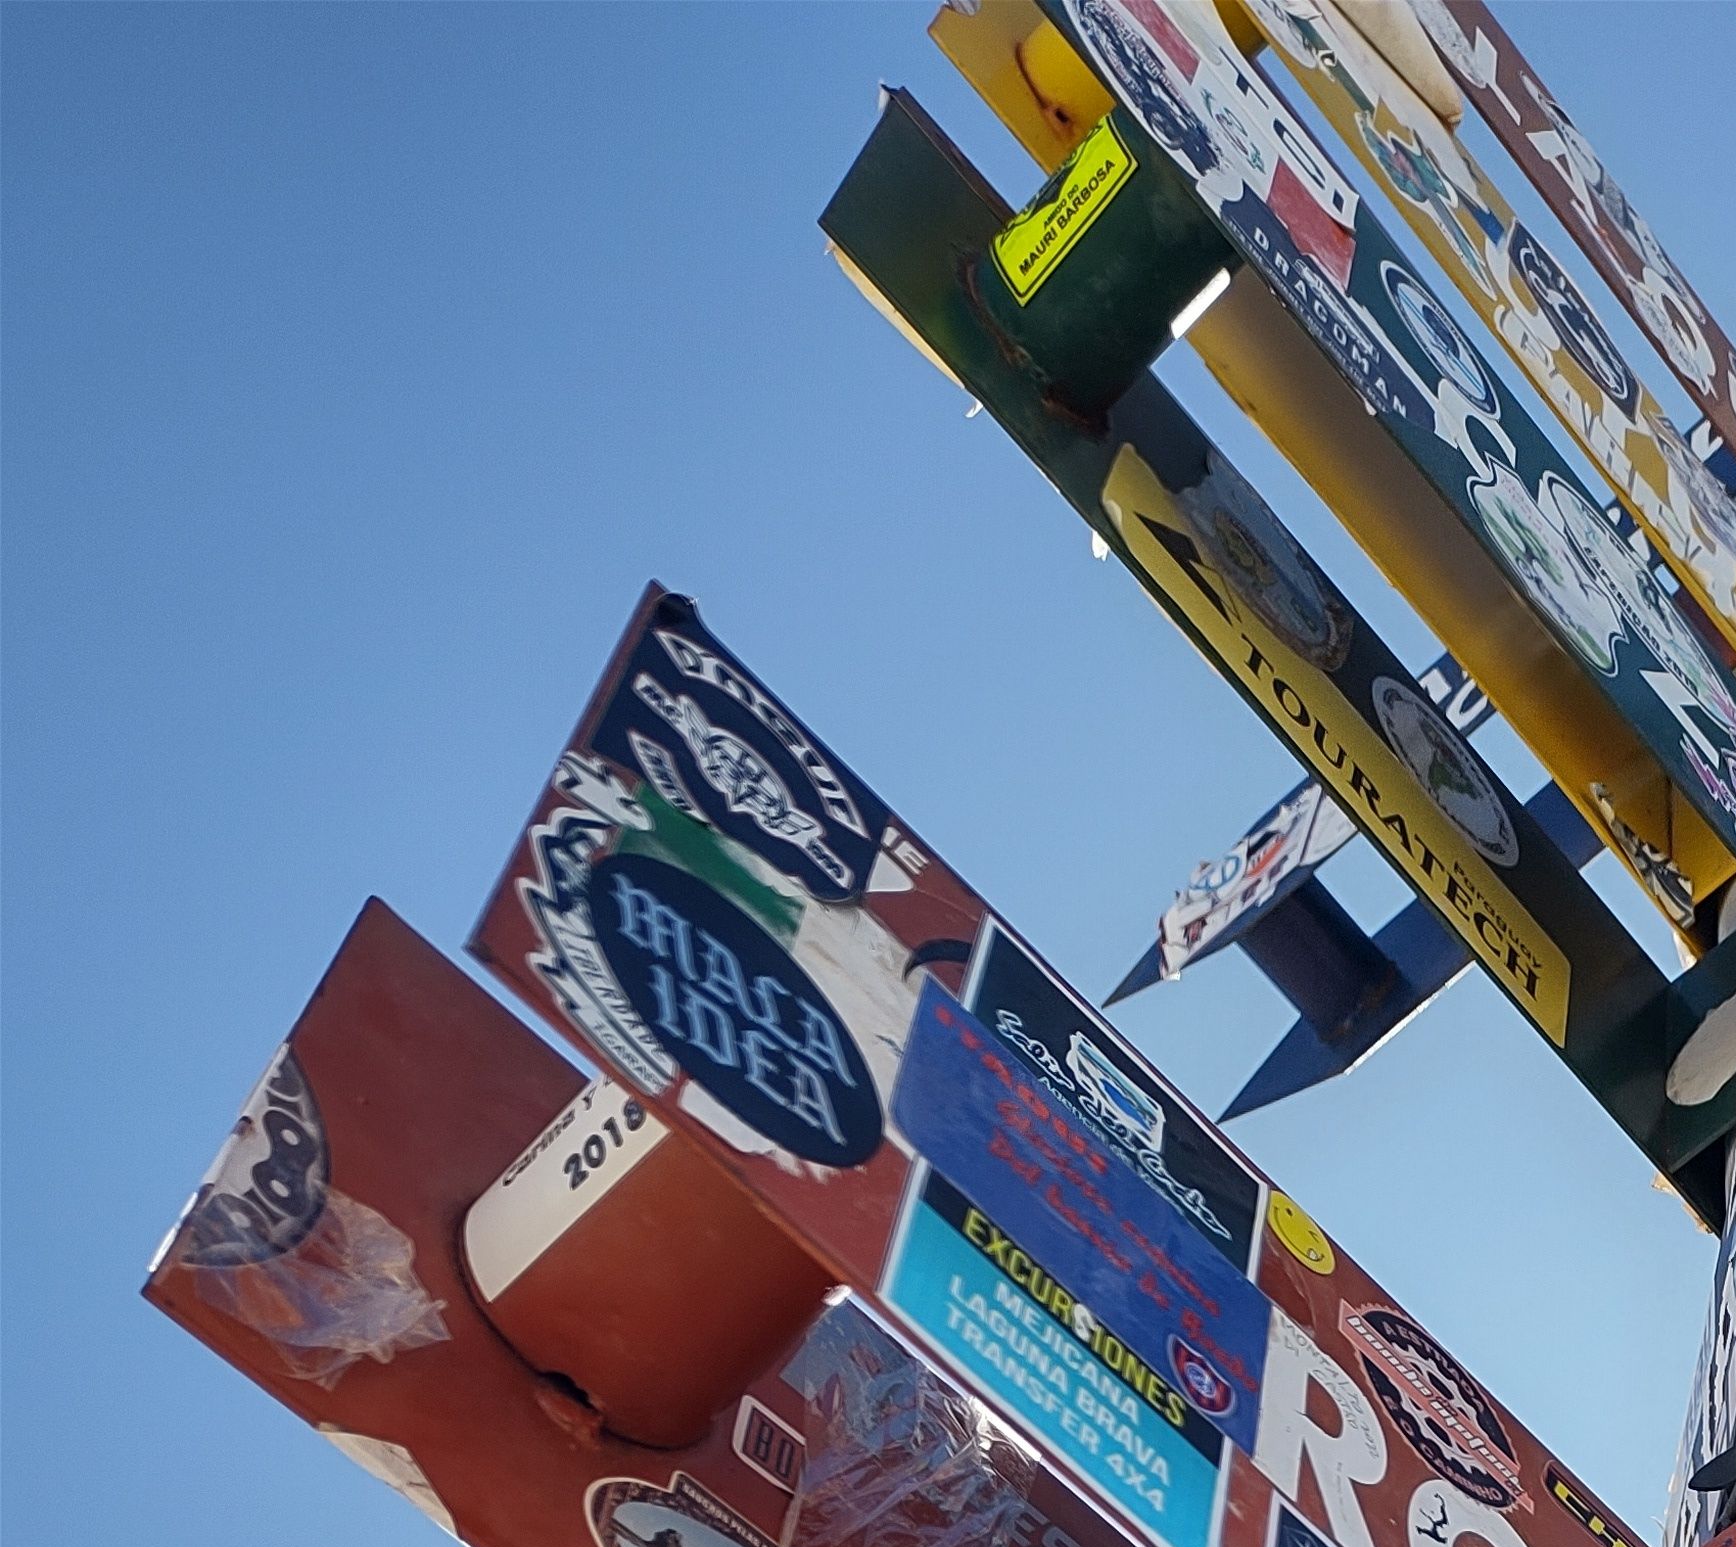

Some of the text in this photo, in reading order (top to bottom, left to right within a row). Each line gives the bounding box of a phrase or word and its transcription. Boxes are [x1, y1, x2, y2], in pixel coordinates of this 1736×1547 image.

[1018, 159, 1116, 277] MAURI BARBOSA
[1253, 226, 1408, 419] DRAGOMAN
[1240, 632, 1540, 1003] TOURATECH
[1453, 859, 1544, 972] Paraguay
[563, 1096, 649, 1191] 2018
[943, 1304, 1101, 1458] TRANSFER
[947, 1272, 1172, 1488] LAGUNA BRAVA
[961, 1208, 1188, 1427] EXCURSIONES
[992, 1272, 1141, 1424] MEJICANA
